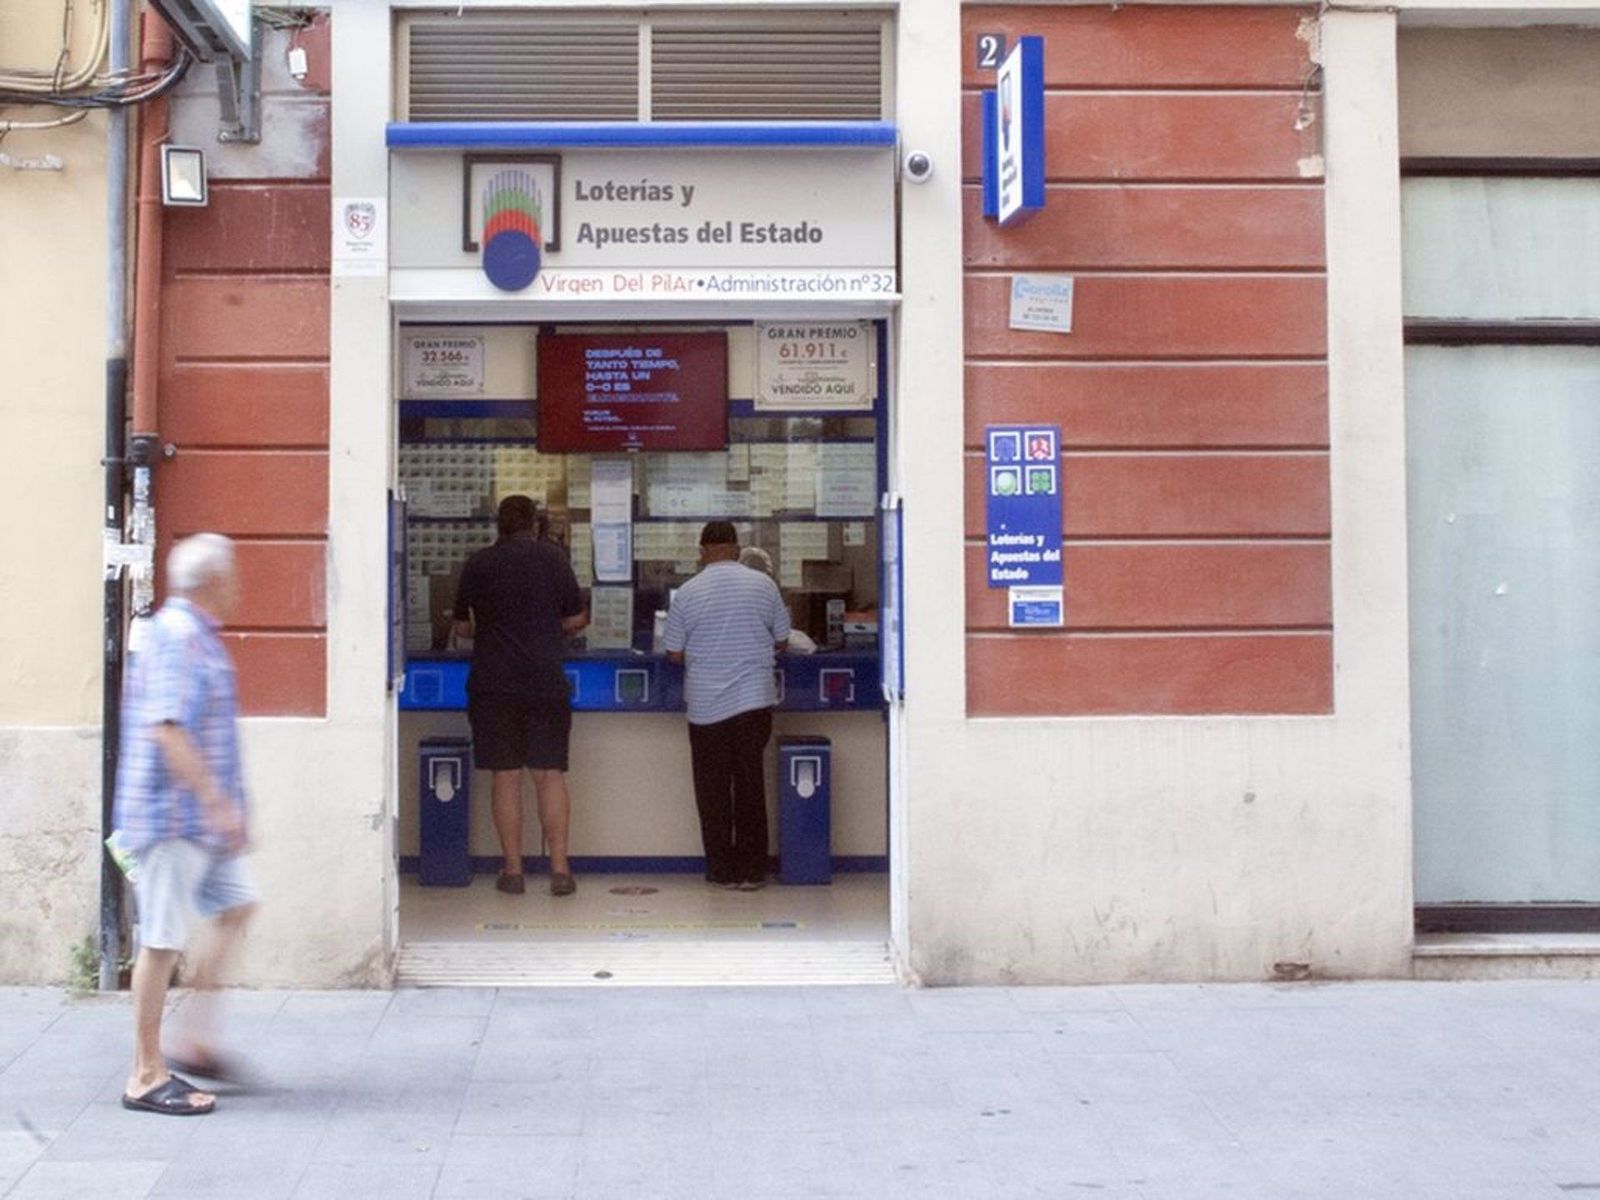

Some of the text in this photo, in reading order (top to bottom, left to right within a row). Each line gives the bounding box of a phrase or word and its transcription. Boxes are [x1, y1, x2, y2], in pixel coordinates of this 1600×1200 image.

[980, 36, 998, 66] 2
[575, 179, 695, 207] Loterías y
[350, 213, 370, 231] 85
[576, 221, 823, 249] Apuestas del Estado
[613, 274, 643, 293] Del
[768, 327, 857, 339] GRAN PREMIO
[780, 343, 836, 358] 61.911
[771, 384, 822, 394] VENDIDO
[1037, 535, 1045, 547] y
[991, 550, 1060, 566] Apuestas del
[991, 566, 1029, 580] Estado
